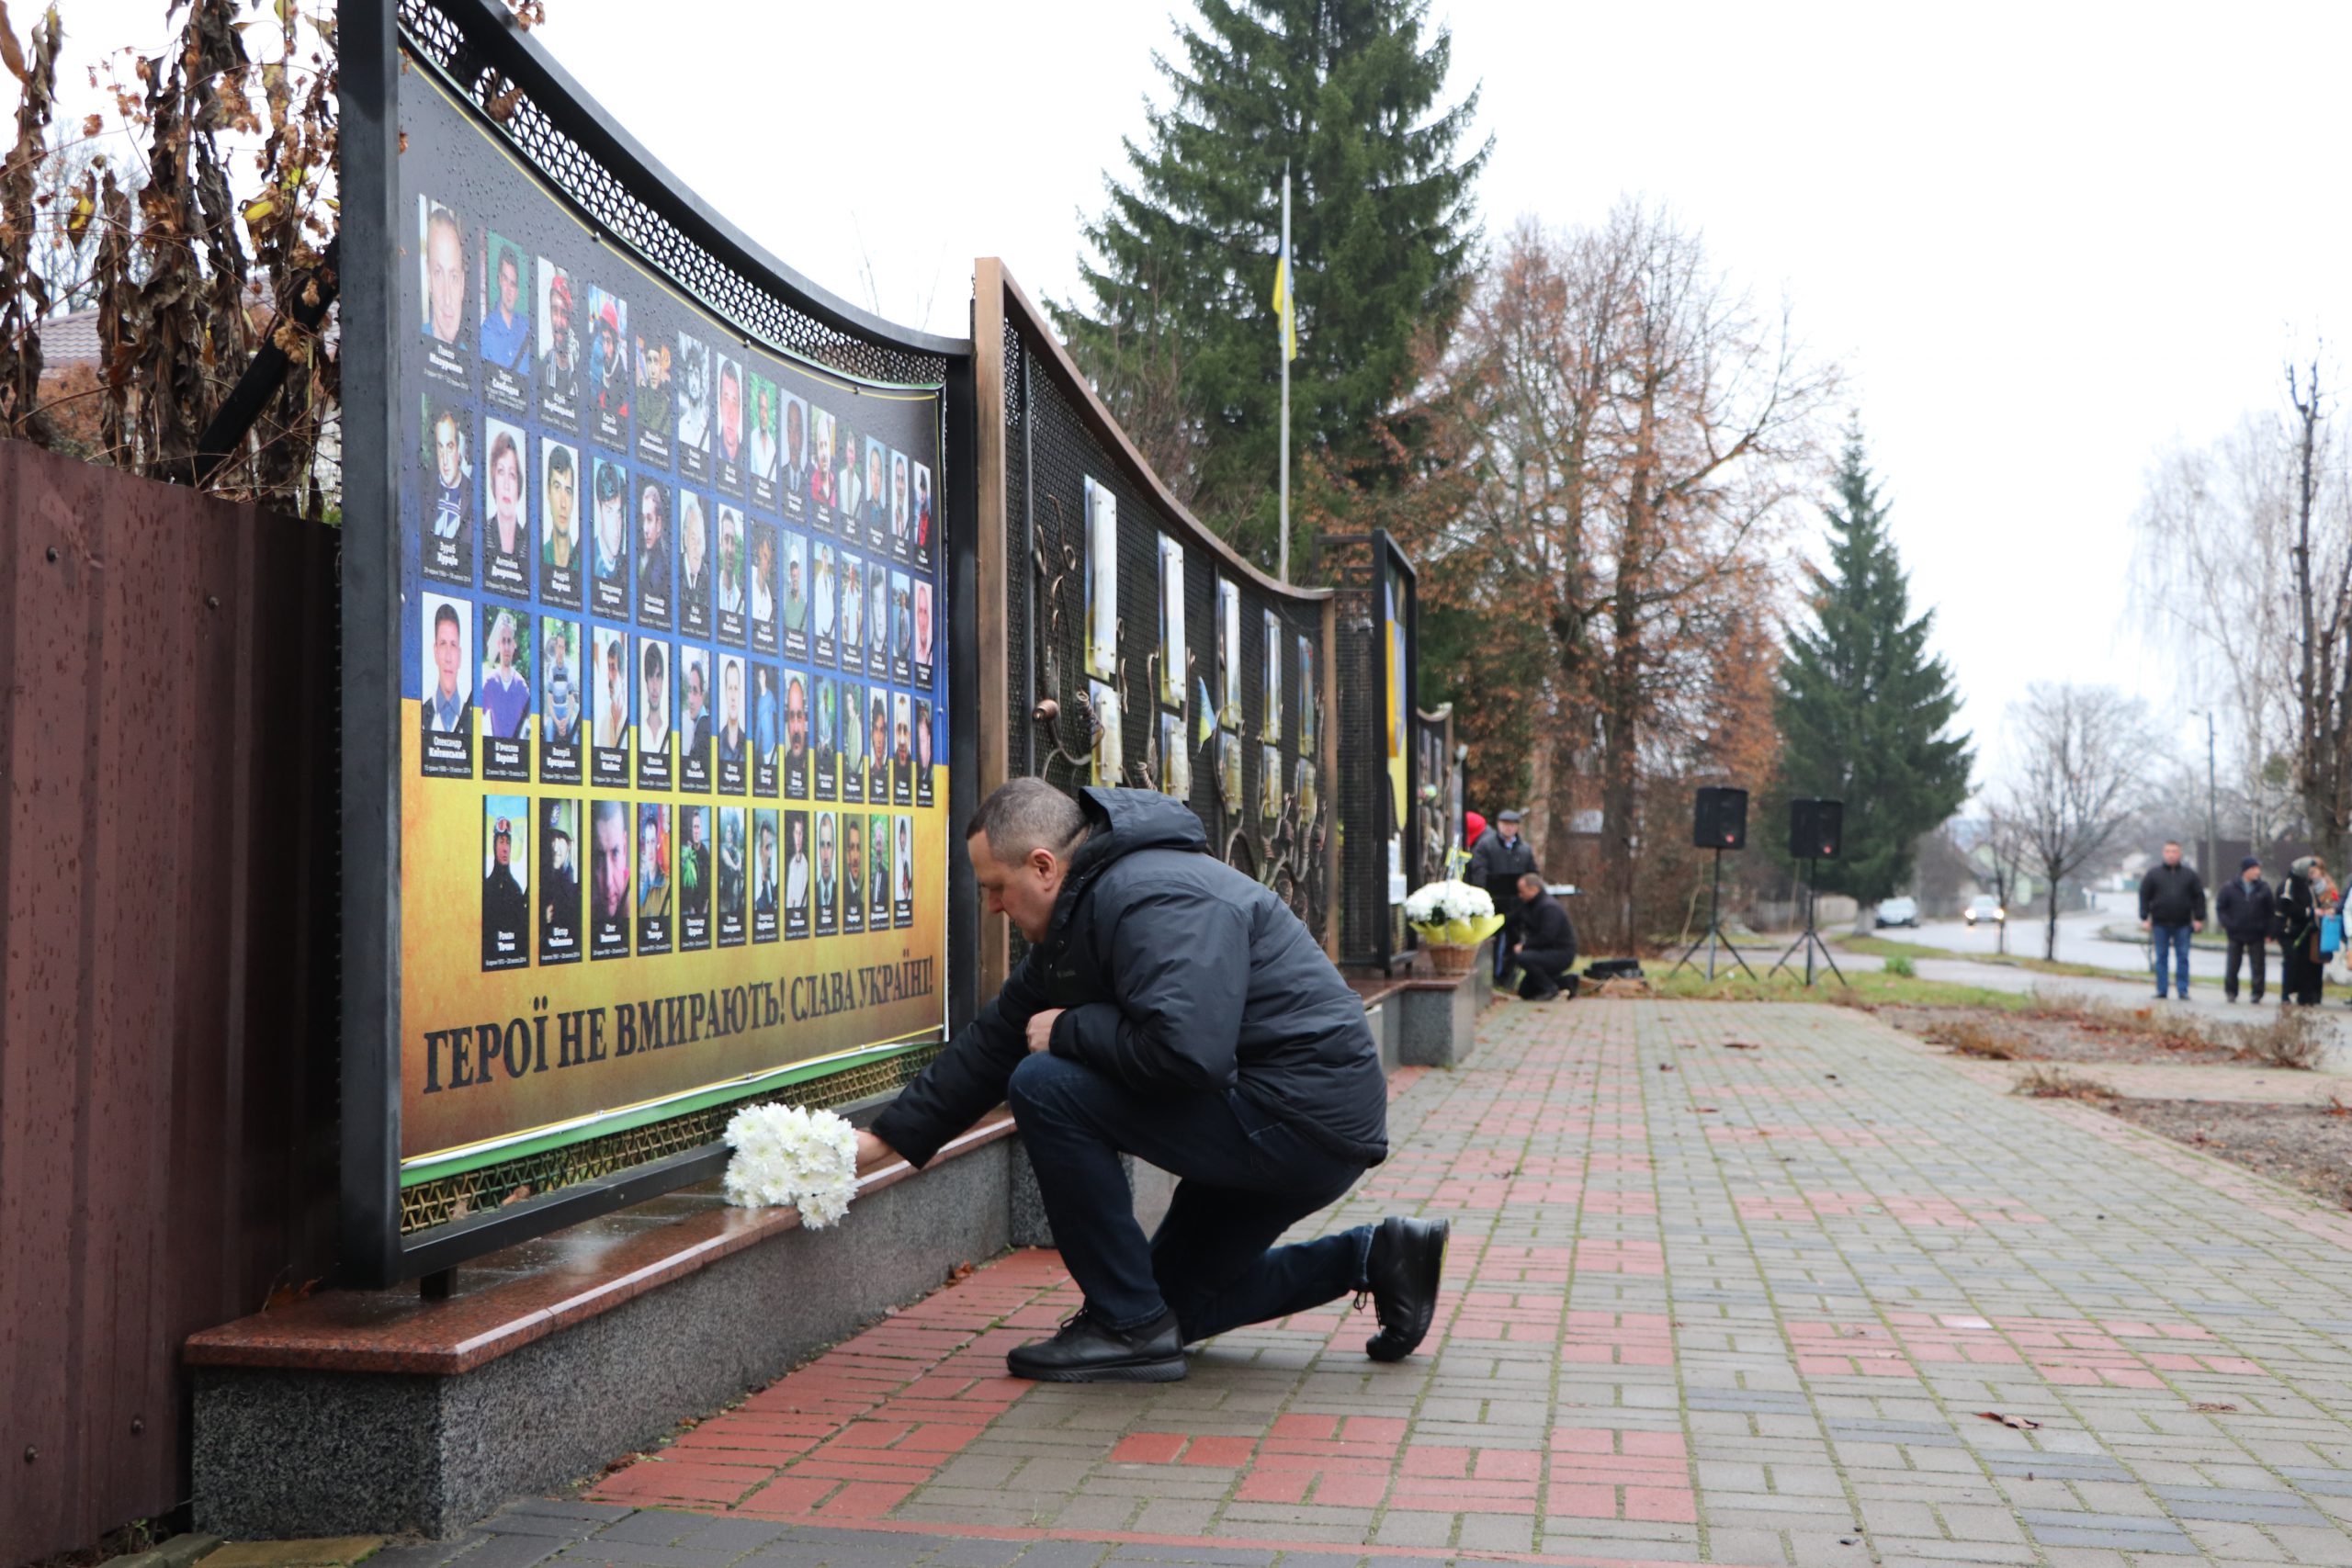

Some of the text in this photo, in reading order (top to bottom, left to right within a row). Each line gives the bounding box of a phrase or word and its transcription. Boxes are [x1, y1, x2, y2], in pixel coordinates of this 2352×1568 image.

[439, 541, 456, 555] Зураб
[423, 949, 933, 1094] ГЕРОЇ НЕ ВМИРАЮТЬ! СЛАВА УКРАЇНІ!
